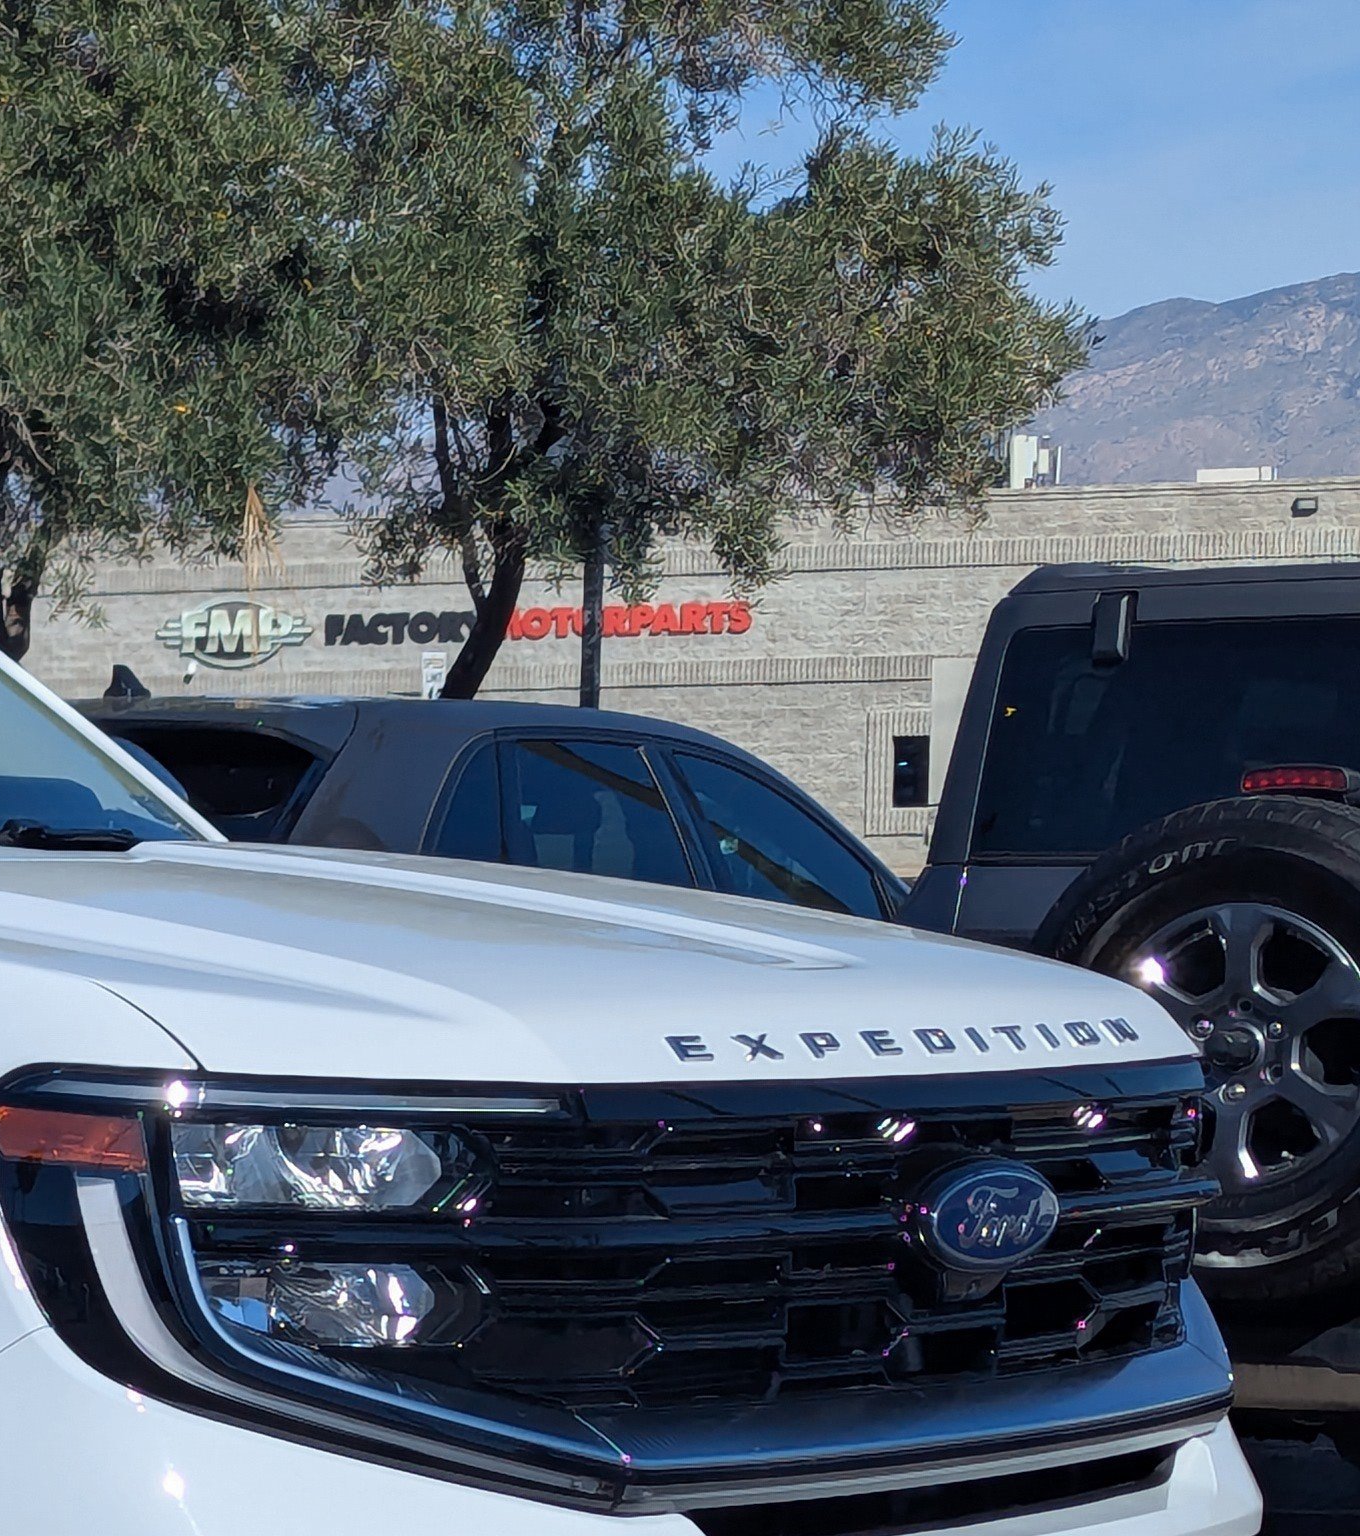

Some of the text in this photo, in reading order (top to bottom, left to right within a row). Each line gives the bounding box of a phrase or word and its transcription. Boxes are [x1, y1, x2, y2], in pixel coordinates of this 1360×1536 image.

[181, 608, 294, 654] FMP
[664, 1015, 1141, 1063] EXPEDITION
[956, 1183, 1042, 1249] Ford
